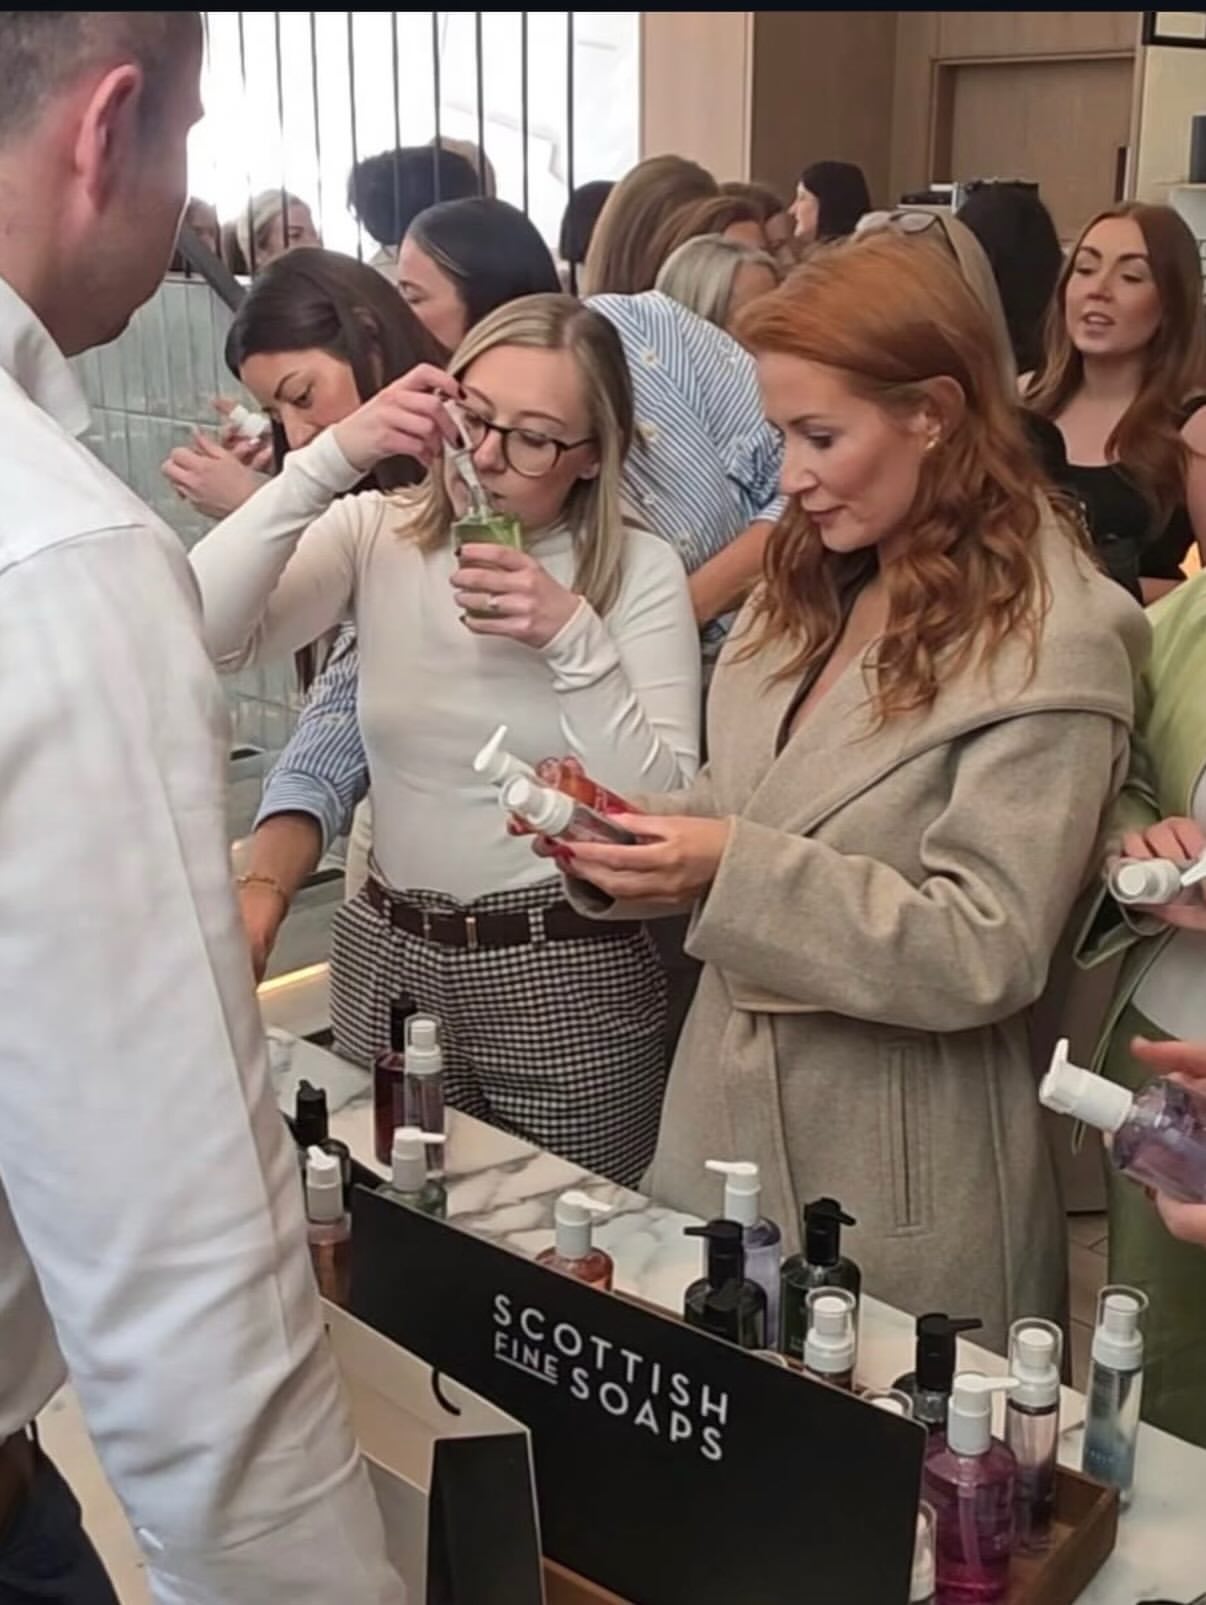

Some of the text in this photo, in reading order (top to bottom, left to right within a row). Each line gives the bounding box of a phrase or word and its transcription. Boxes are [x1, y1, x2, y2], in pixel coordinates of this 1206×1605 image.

[494, 1294, 728, 1425] SCOTTISH
[494, 1331, 723, 1461] FINE SOAPS
